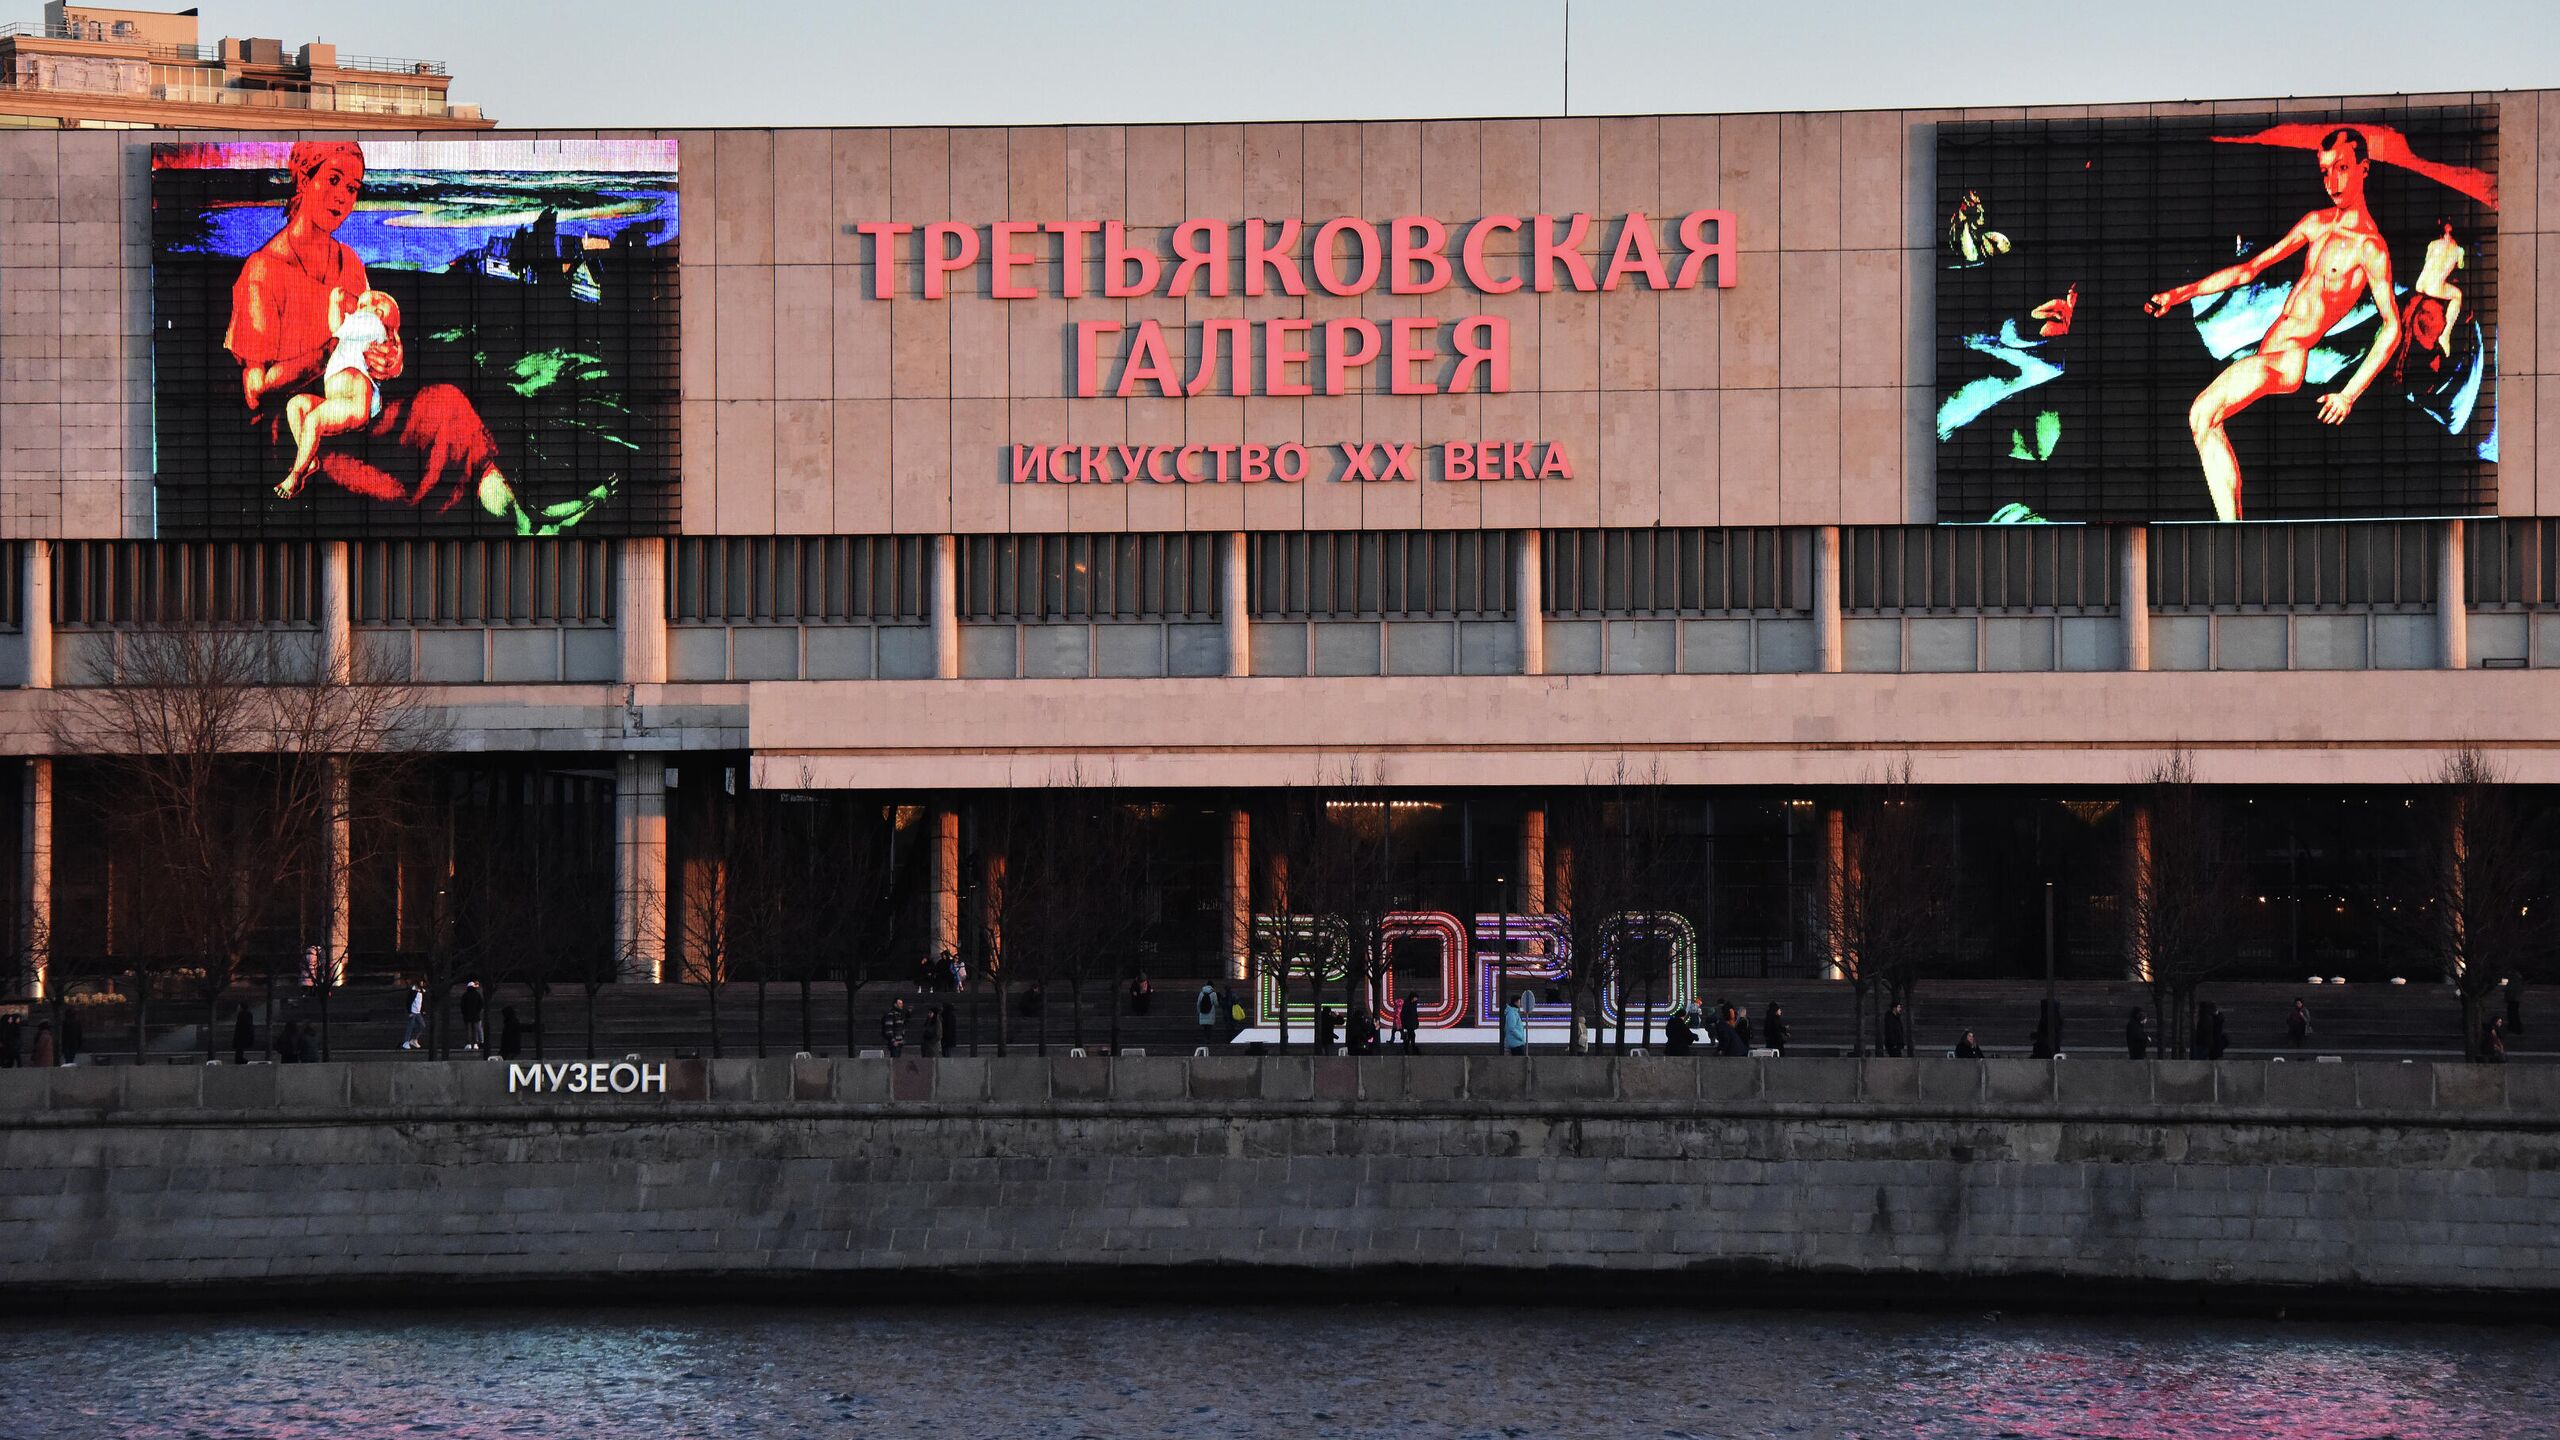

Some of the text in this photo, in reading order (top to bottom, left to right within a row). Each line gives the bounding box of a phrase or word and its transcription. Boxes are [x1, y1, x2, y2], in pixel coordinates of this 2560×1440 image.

[857, 209, 1738, 300] ТРЕТЬЯКОВСКАЯ
[1077, 315, 1511, 397] ГАЛЕРЕЯ
[1012, 442, 1310, 484] ИСКУССТВО
[1444, 440, 1573, 481] ВЕКА
[1256, 911, 1697, 1028] 2020
[509, 1063, 667, 1093] МУЗЕОН
